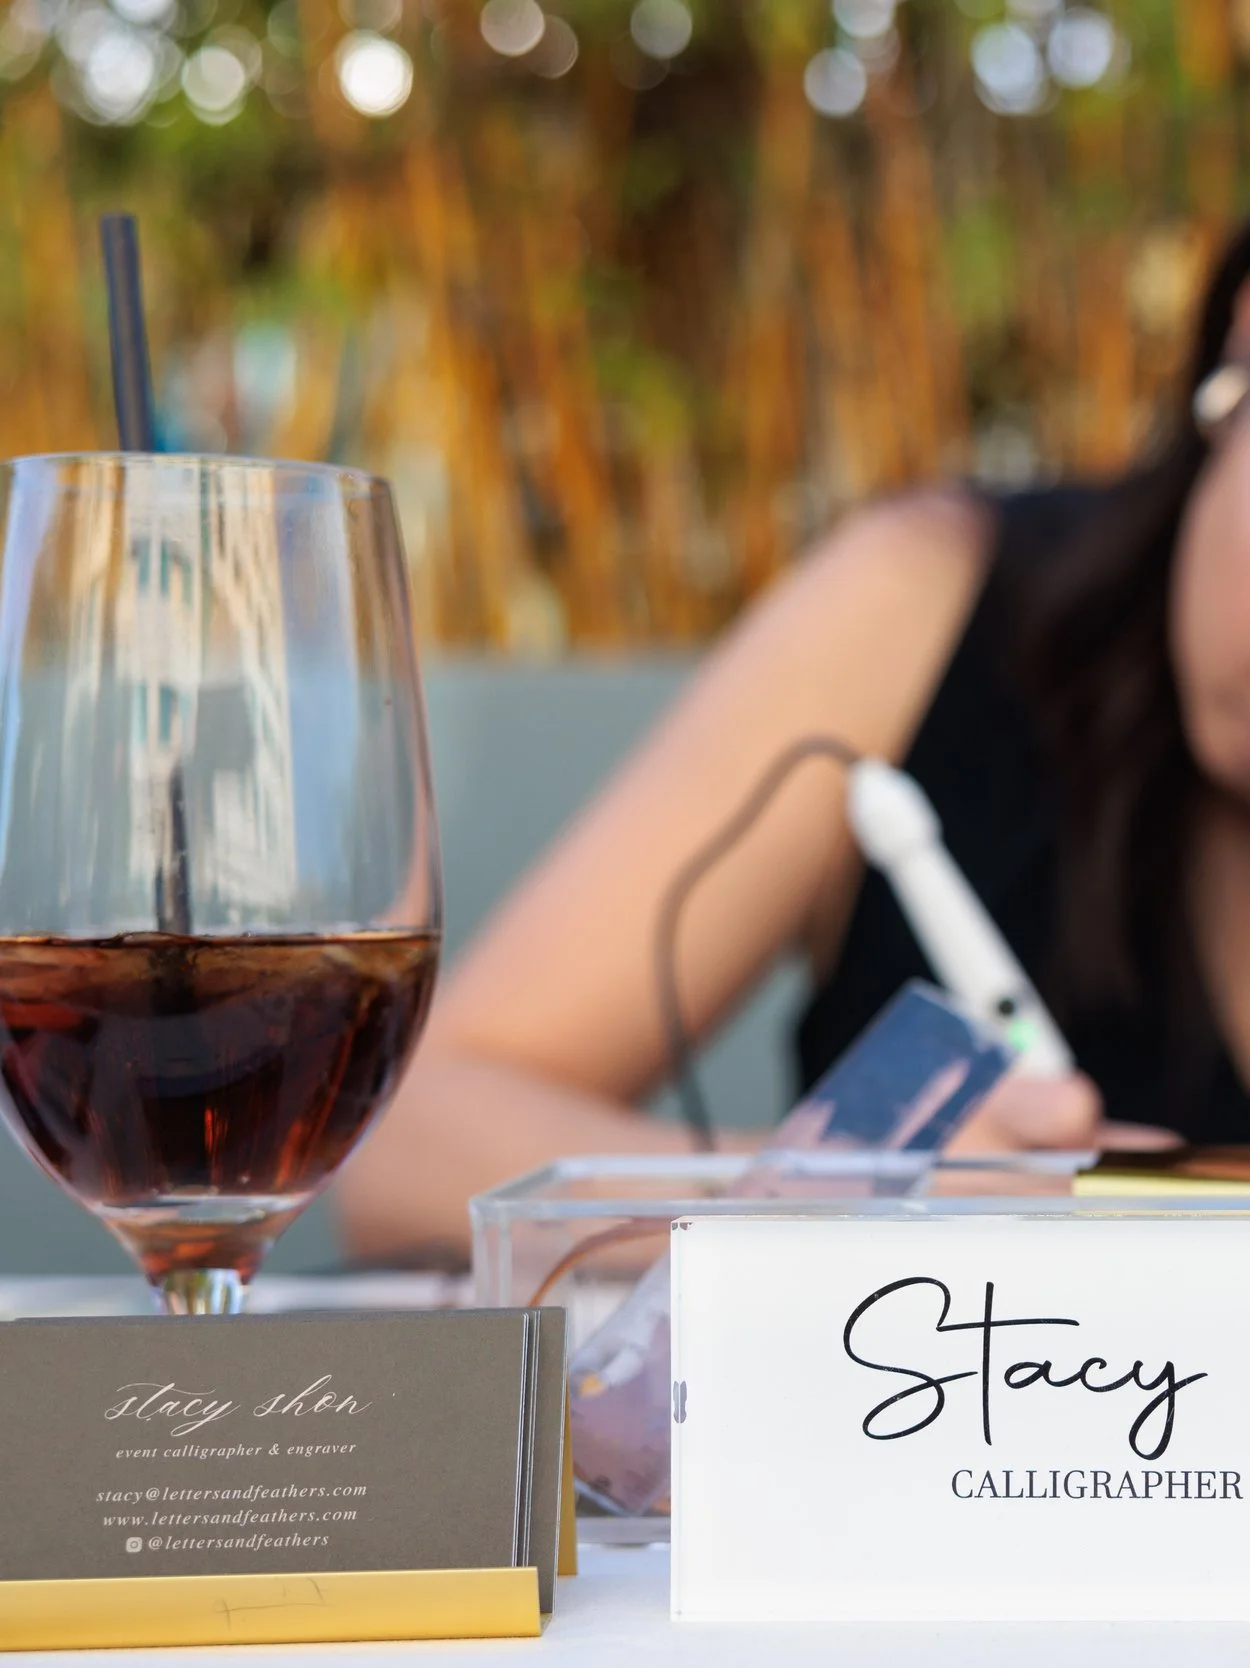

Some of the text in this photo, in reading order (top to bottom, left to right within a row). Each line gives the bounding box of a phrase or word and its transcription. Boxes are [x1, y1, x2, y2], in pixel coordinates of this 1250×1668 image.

[842, 1276, 1209, 1461] Stacy
[104, 1374, 373, 1437] stacy shon
[115, 1442, 357, 1460] event calligrapher & engraver
[95, 1483, 368, 1505] stacy@lettersandfeathers.com
[951, 1469, 1244, 1500] CALLIGRAPHER
[102, 1508, 358, 1528] www.lettersandfeathers.com
[147, 1532, 330, 1552] @lettersandfeathers
